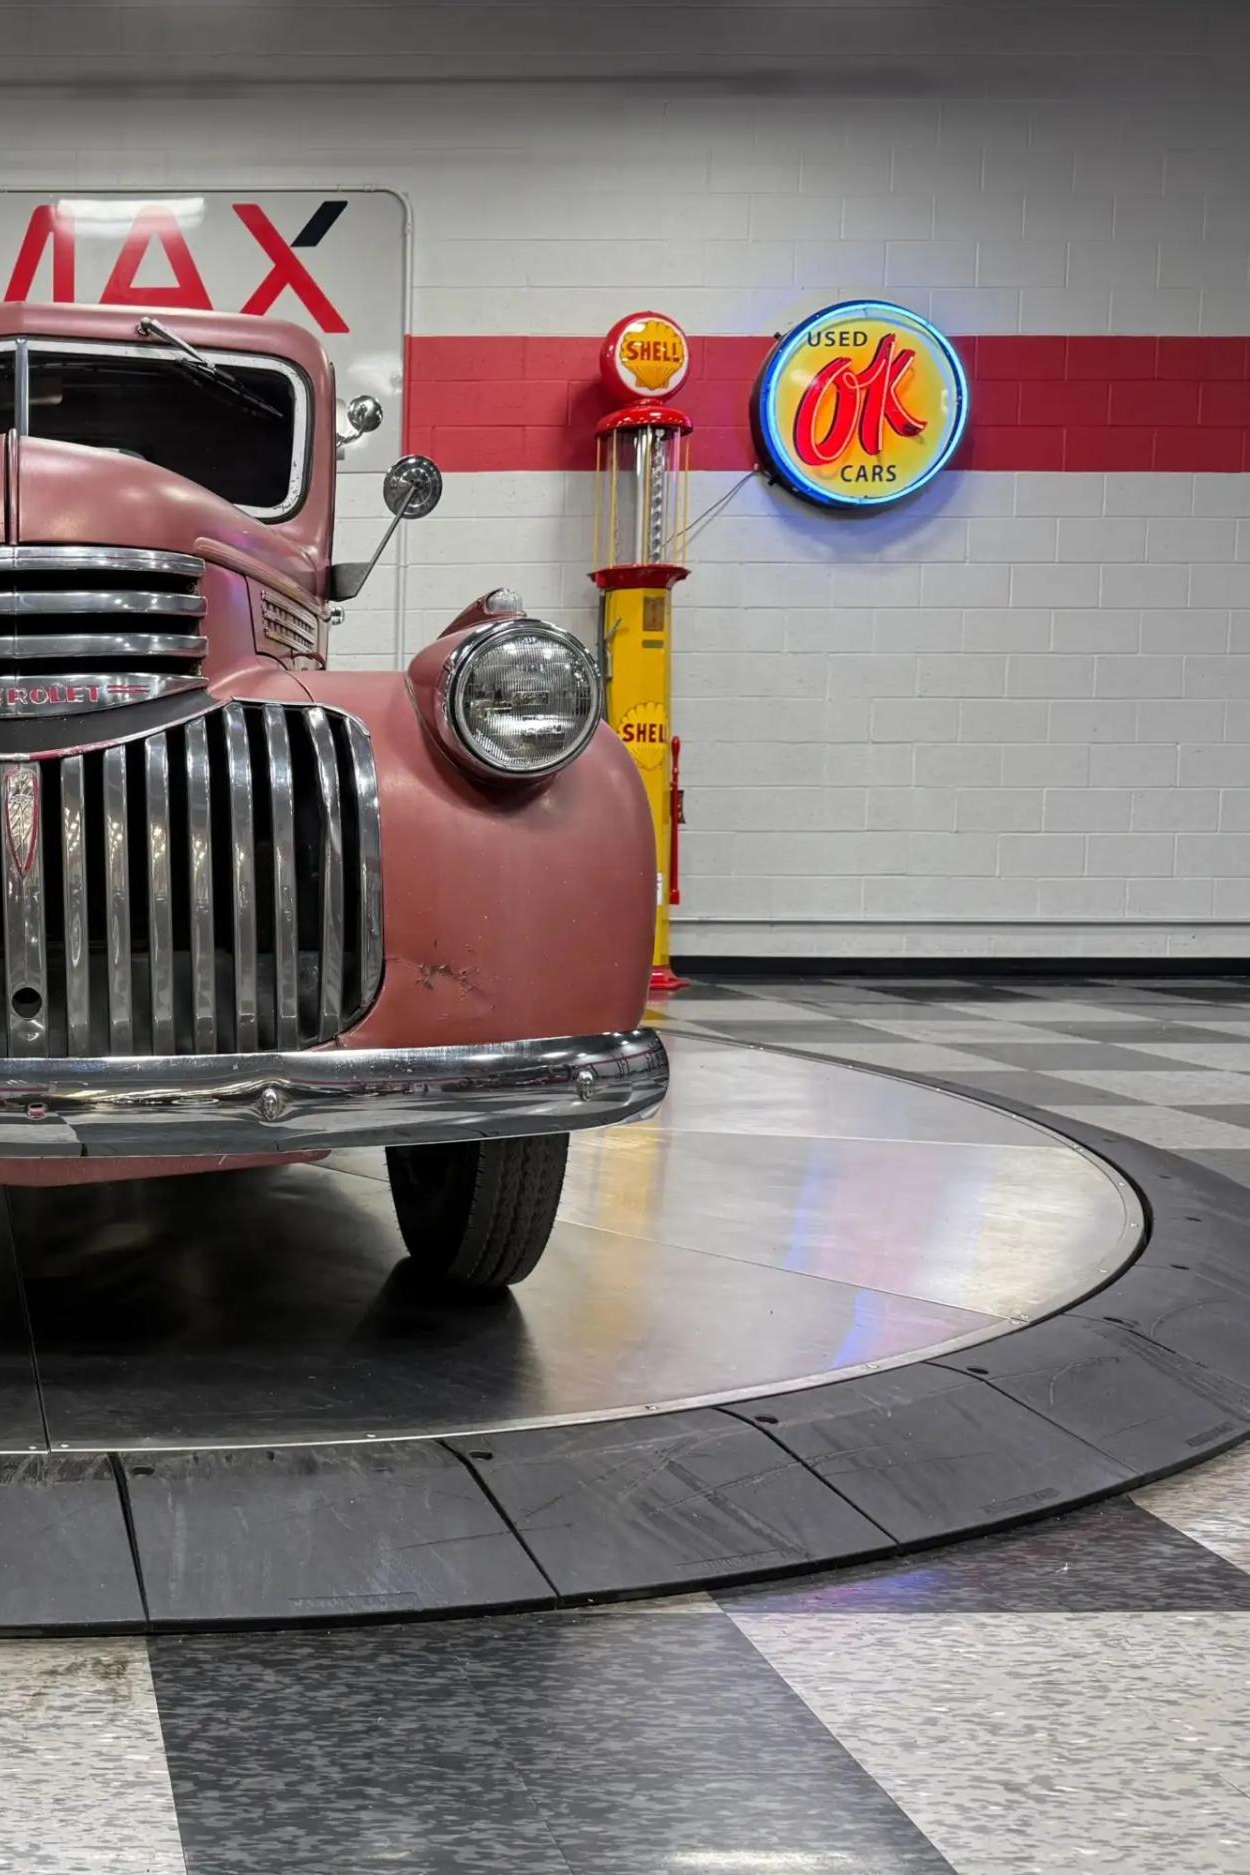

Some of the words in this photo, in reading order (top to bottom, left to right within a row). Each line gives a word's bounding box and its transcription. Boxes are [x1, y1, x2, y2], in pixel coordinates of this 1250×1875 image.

[807, 331, 868, 347] USED
[626, 341, 680, 362] SHELL
[793, 333, 927, 466] OK
[840, 464, 897, 483] CARS
[622, 723, 668, 743] SHEL
